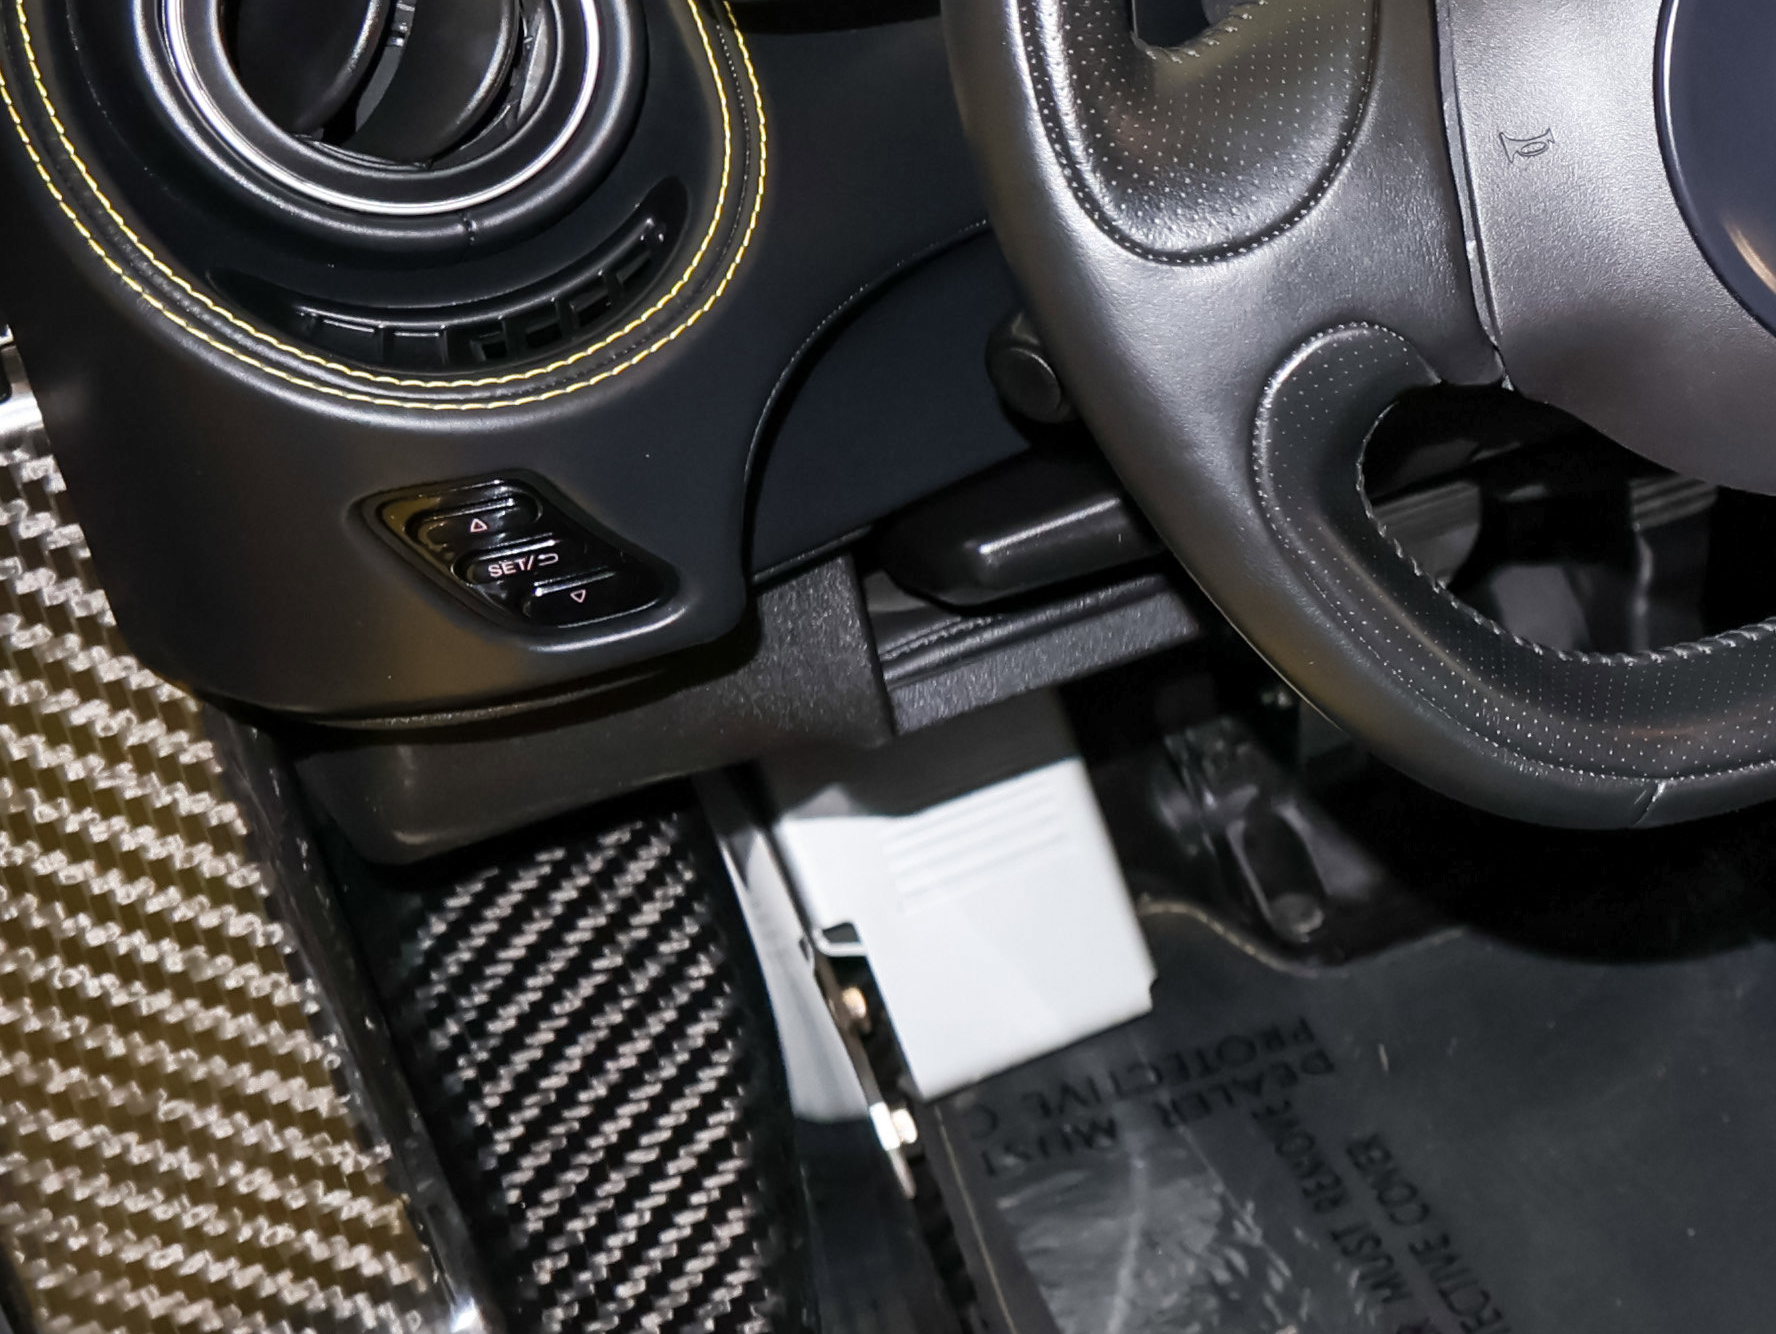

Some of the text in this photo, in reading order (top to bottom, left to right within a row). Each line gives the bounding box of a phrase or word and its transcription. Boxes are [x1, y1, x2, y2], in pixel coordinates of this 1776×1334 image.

[1154, 1048, 1334, 1130] DEALER
[1343, 1131, 1431, 1233] COVER
[1329, 1217, 1414, 1309] MUST
